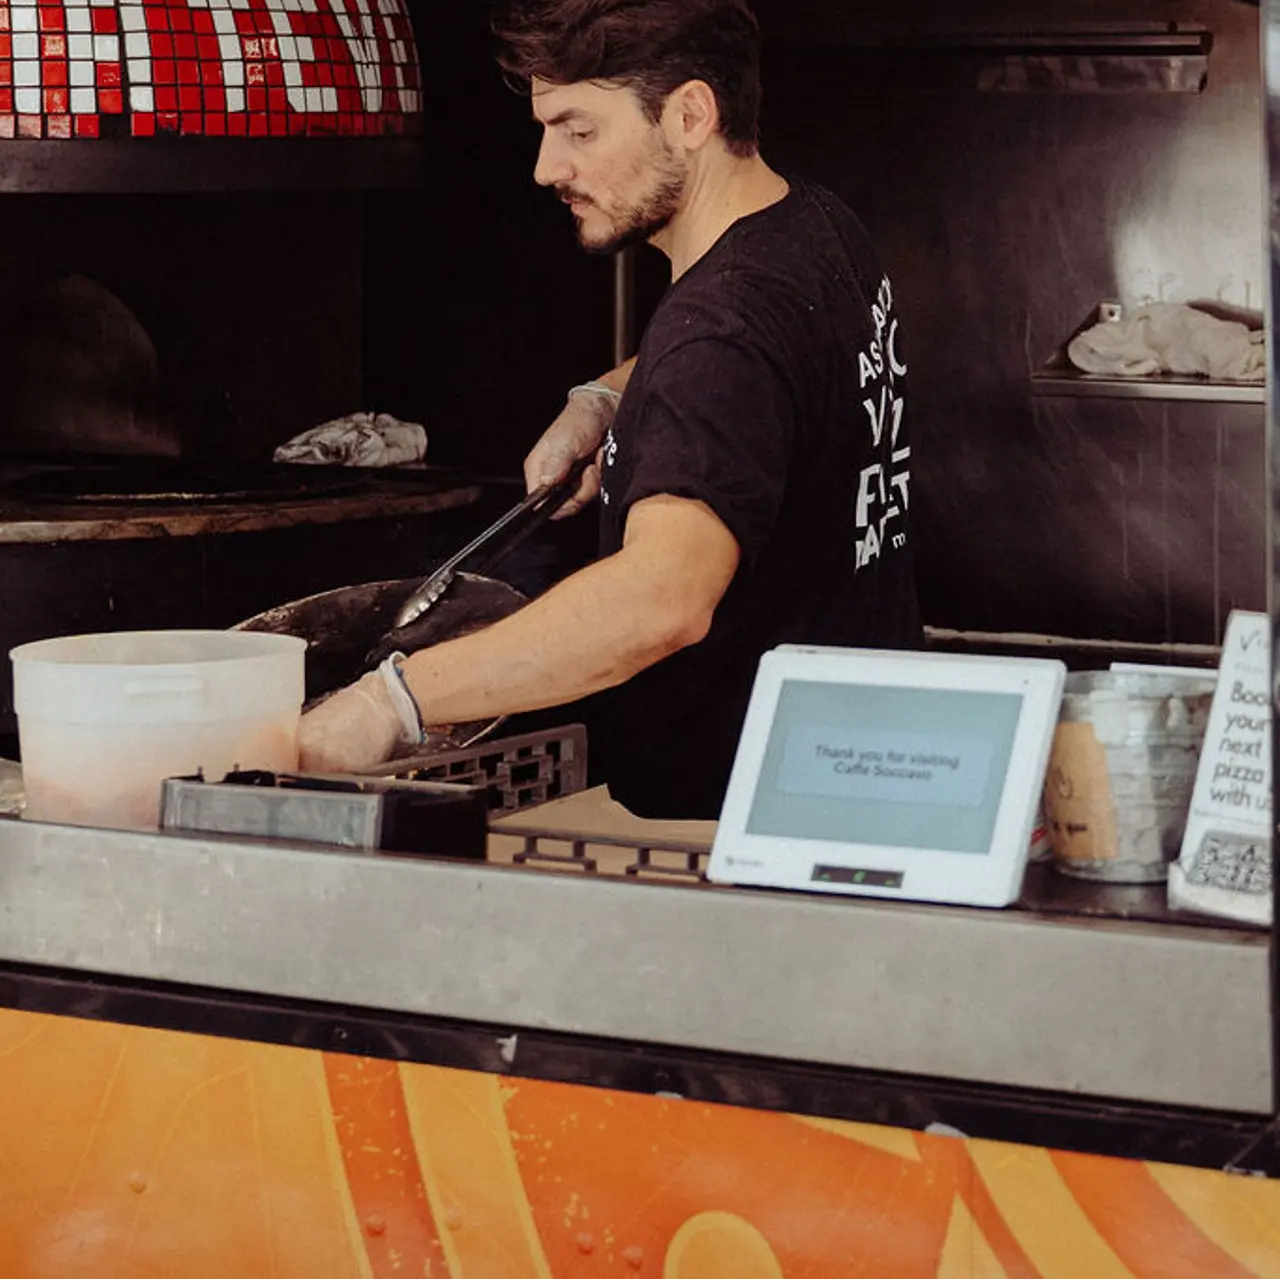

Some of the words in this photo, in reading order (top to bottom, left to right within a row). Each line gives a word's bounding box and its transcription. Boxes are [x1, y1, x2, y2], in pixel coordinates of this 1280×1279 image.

[1230, 679, 1270, 706] Boo
[859, 749, 884, 763] you
[1219, 734, 1262, 759] next
[1212, 757, 1265, 784] pizza
[1209, 779, 1252, 809] with
